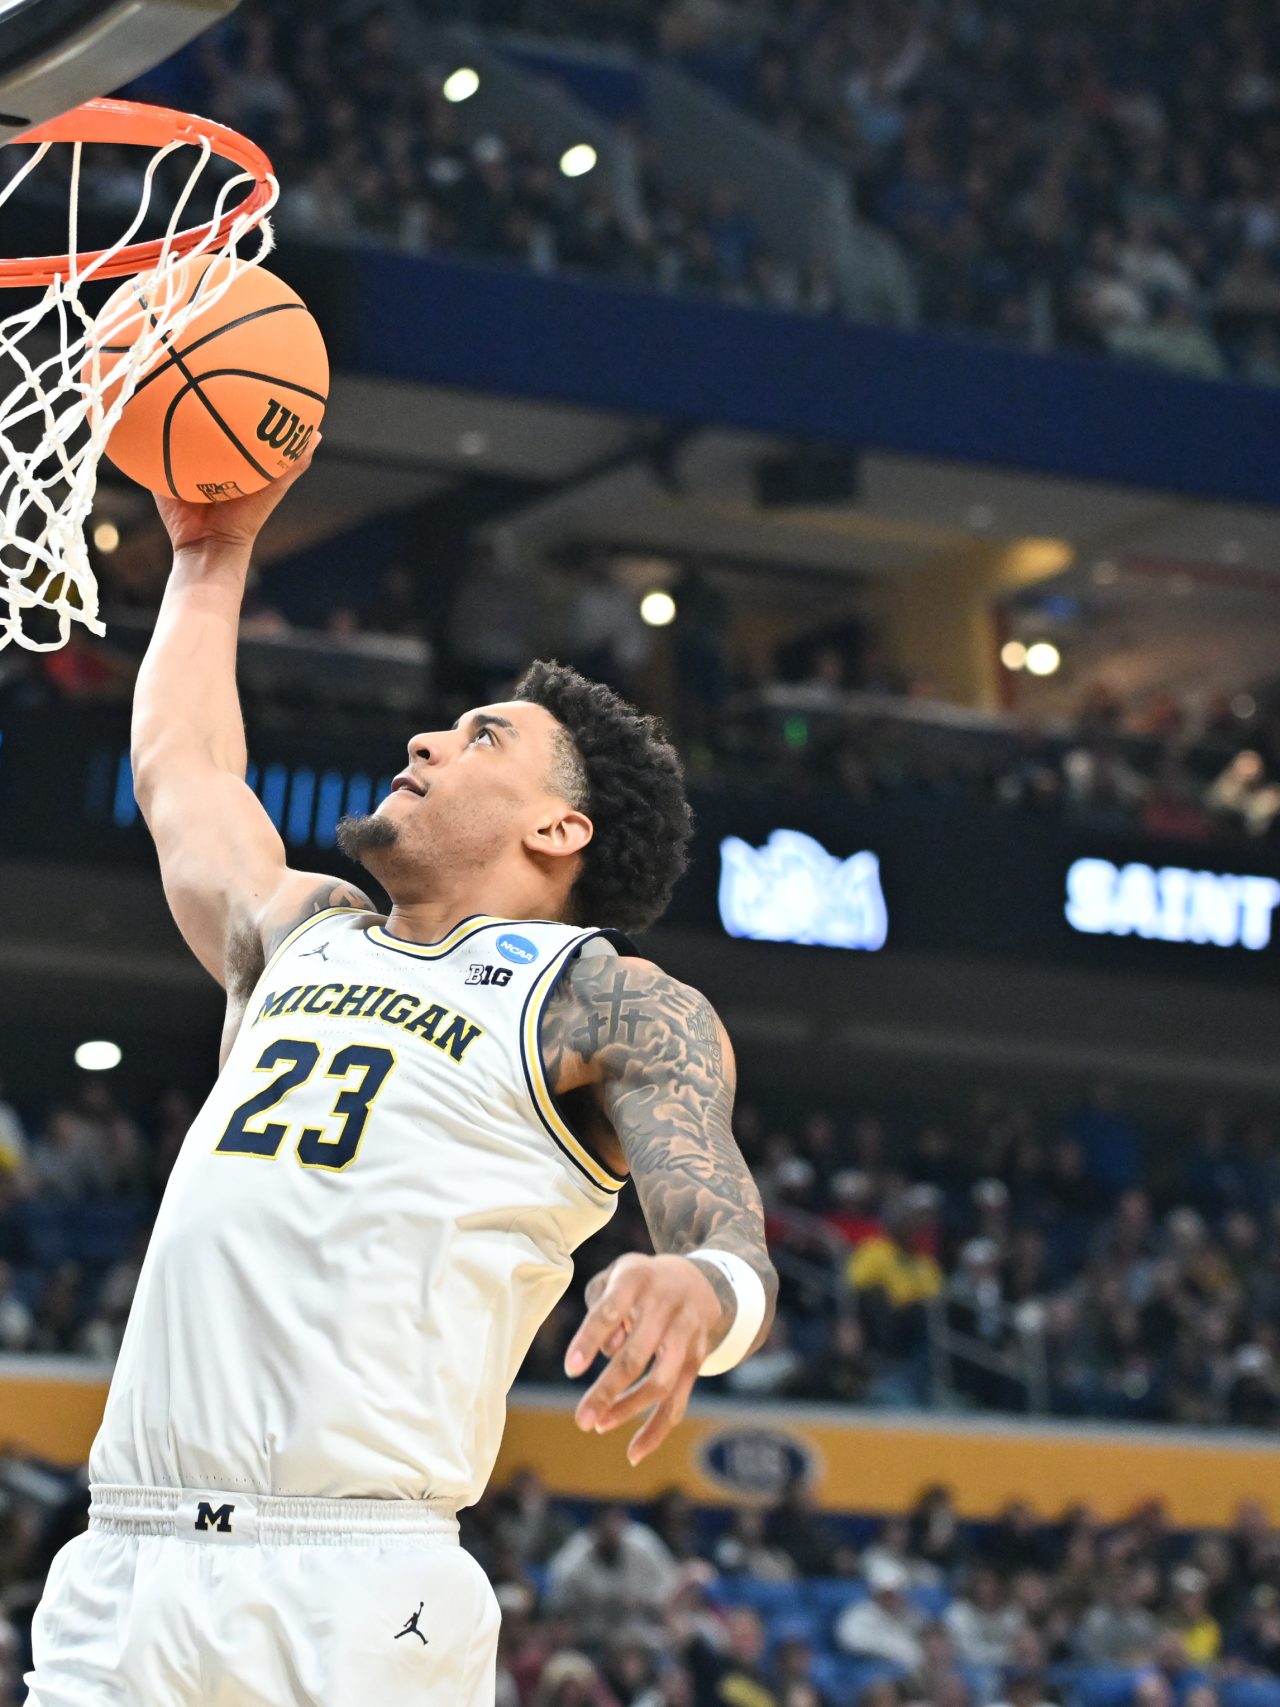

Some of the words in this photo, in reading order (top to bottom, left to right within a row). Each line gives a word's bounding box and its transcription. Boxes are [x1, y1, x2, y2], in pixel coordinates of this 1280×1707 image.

[256, 398, 313, 461] Wil
[1064, 857, 1280, 950] SAINT
[500, 940, 535, 961] NCAA
[251, 983, 483, 1064] MICHIGAN
[211, 1038, 398, 1173] 23
[194, 1501, 236, 1533] M
